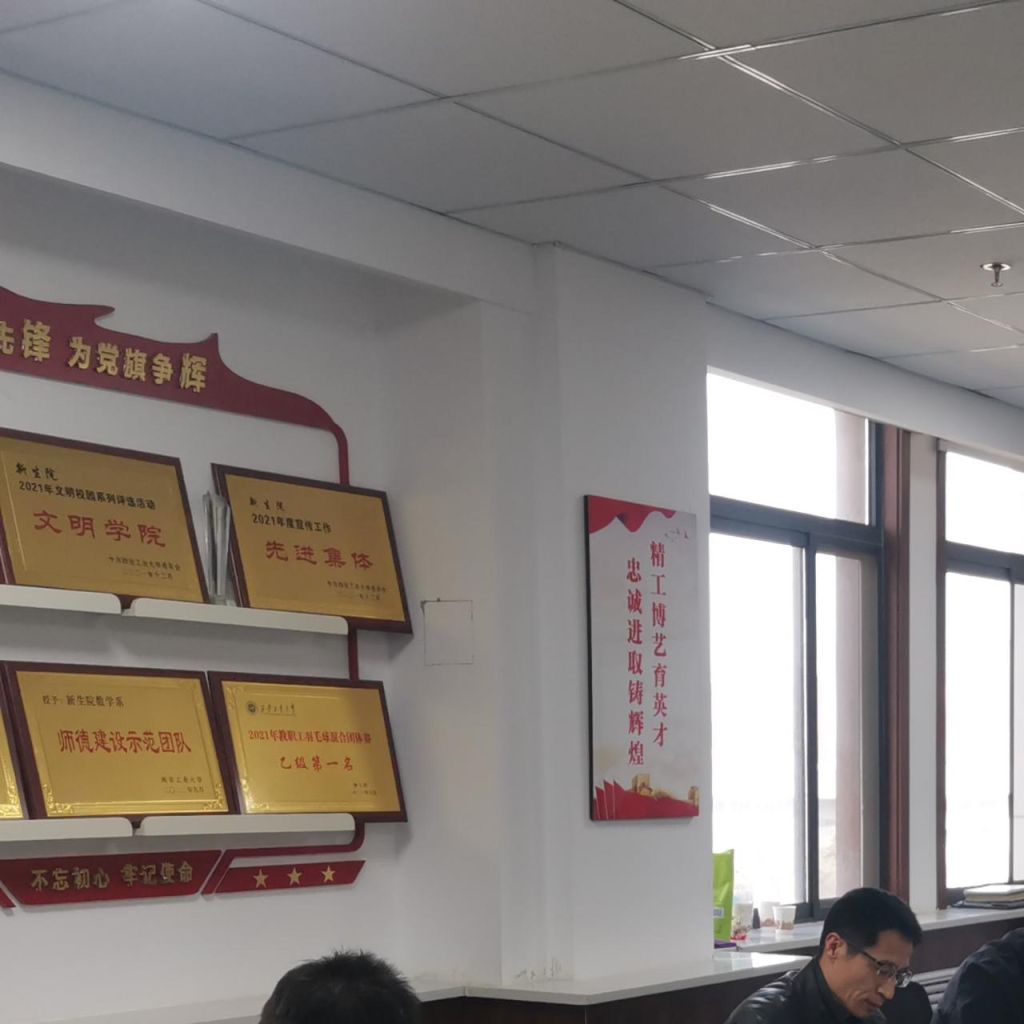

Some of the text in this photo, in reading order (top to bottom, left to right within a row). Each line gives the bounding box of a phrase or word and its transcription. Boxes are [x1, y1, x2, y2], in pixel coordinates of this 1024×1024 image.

[0, 318, 207, 393] 先锋 为党旗争辉
[33, 509, 166, 548] 文明学院
[251, 513, 332, 534] 2021年度宣传工作
[265, 540, 373, 571] 先进集体
[626, 556, 645, 766] 忠诚进取铸辉煌
[649, 540, 668, 747] 精工博艺育英才
[57, 728, 192, 754] 师德建设示范团队
[30, 861, 194, 892] 不忘初心 牢记使命
